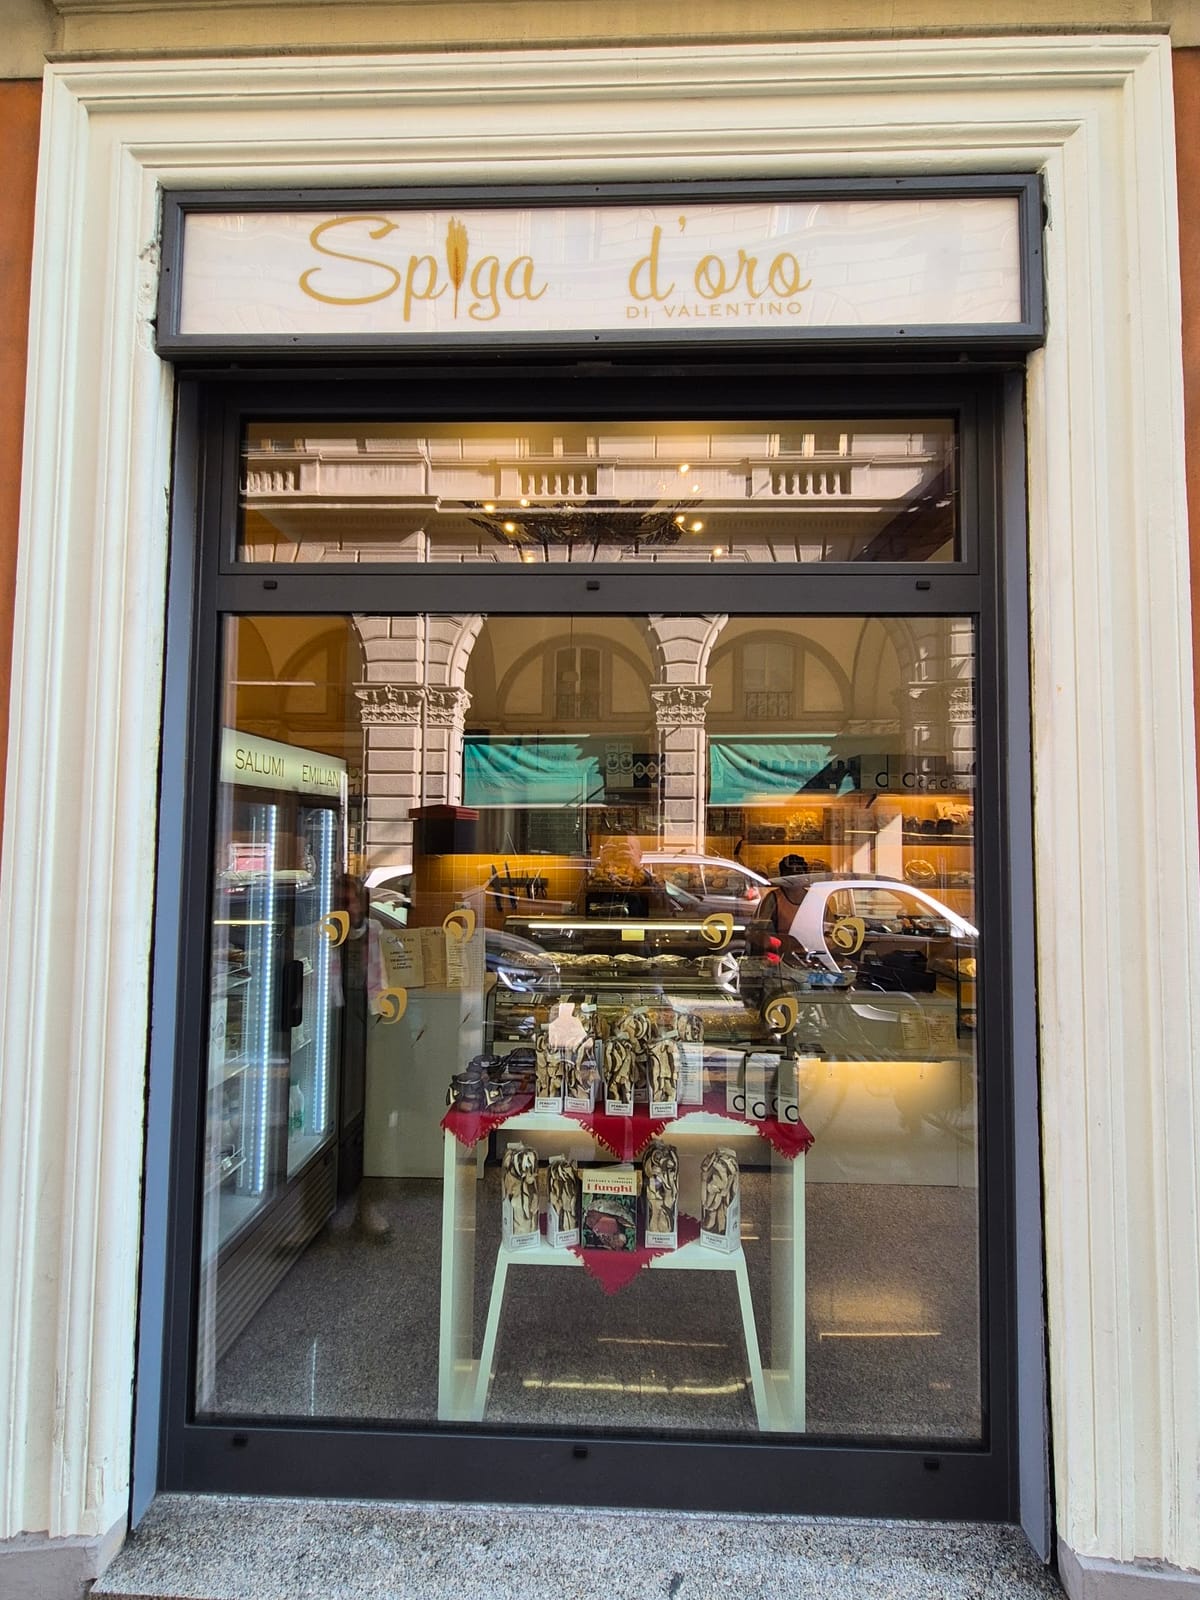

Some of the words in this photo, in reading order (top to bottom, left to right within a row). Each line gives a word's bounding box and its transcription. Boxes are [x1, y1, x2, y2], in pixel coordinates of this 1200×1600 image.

[628, 215, 813, 302] d'oro
[626, 305, 648, 319] DI
[664, 303, 802, 317] VALENTINO
[235, 748, 284, 777] SALUMI
[594, 1184, 632, 1193] funghi
